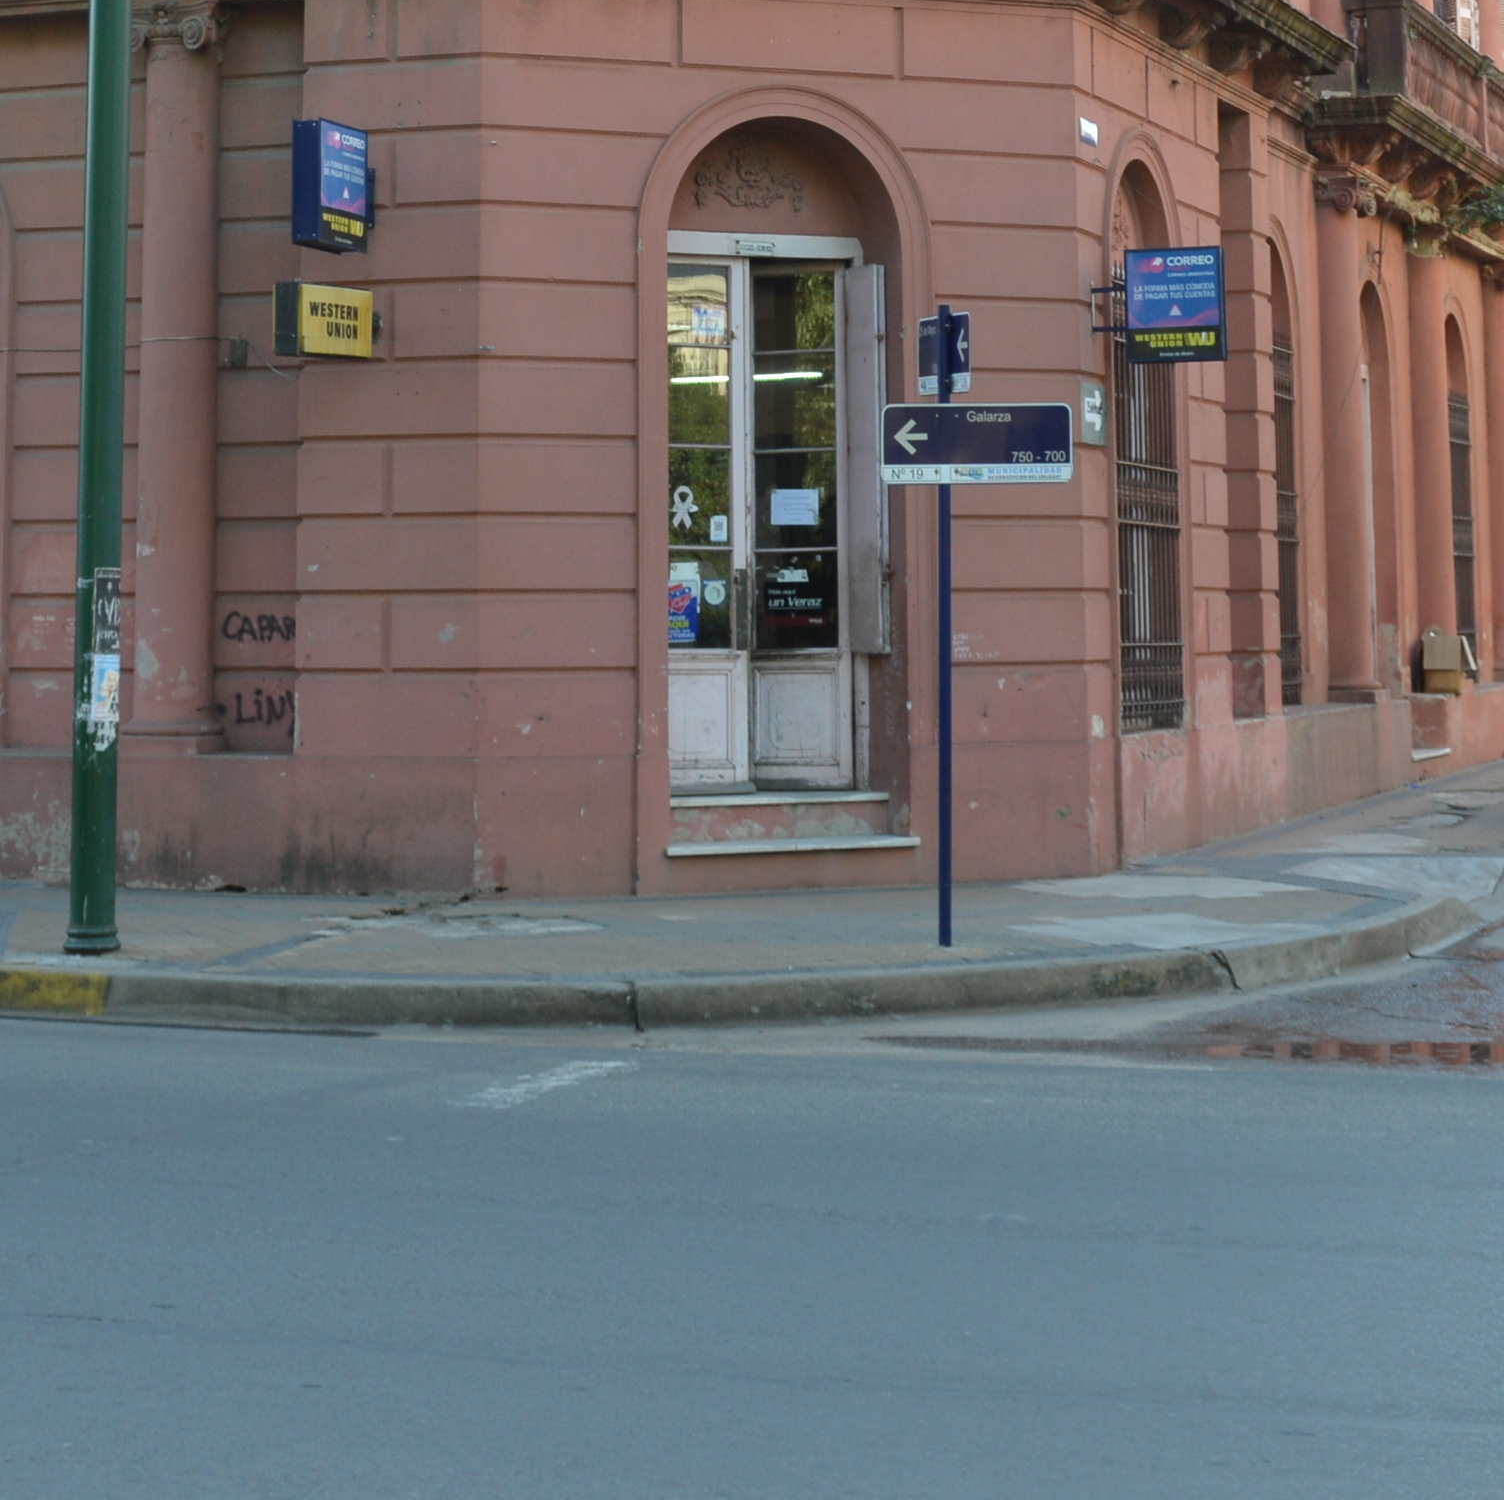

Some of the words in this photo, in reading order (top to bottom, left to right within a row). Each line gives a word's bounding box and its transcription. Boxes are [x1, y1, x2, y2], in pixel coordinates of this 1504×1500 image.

[341, 134, 366, 150] CORREO
[322, 212, 349, 226] WESTERN
[330, 222, 349, 233] UNION
[1166, 254, 1215, 267] CORREO
[1133, 285, 1144, 293] LA
[1144, 284, 1168, 292] FORMA
[1133, 293, 1144, 301] DE
[1144, 292, 1169, 300] PAGAR
[1169, 291, 1184, 299] TUS
[1184, 289, 1216, 299] CUENTAS
[309, 301, 359, 321] WESTERN
[326, 321, 358, 340] UNION
[1134, 332, 1183, 342] WESTERN
[1186, 331, 1216, 347] WU
[1149, 339, 1184, 349] UNION
[966, 410, 1012, 423] Galarza
[1011, 451, 1034, 463] 750
[1044, 450, 1066, 462] 700
[891, 468, 906, 480] Nº
[910, 468, 924, 480] 19
[987, 466, 1063, 474] MUNICIPALIDAD
[768, 598, 785, 607] un
[787, 596, 823, 607] Veraz
